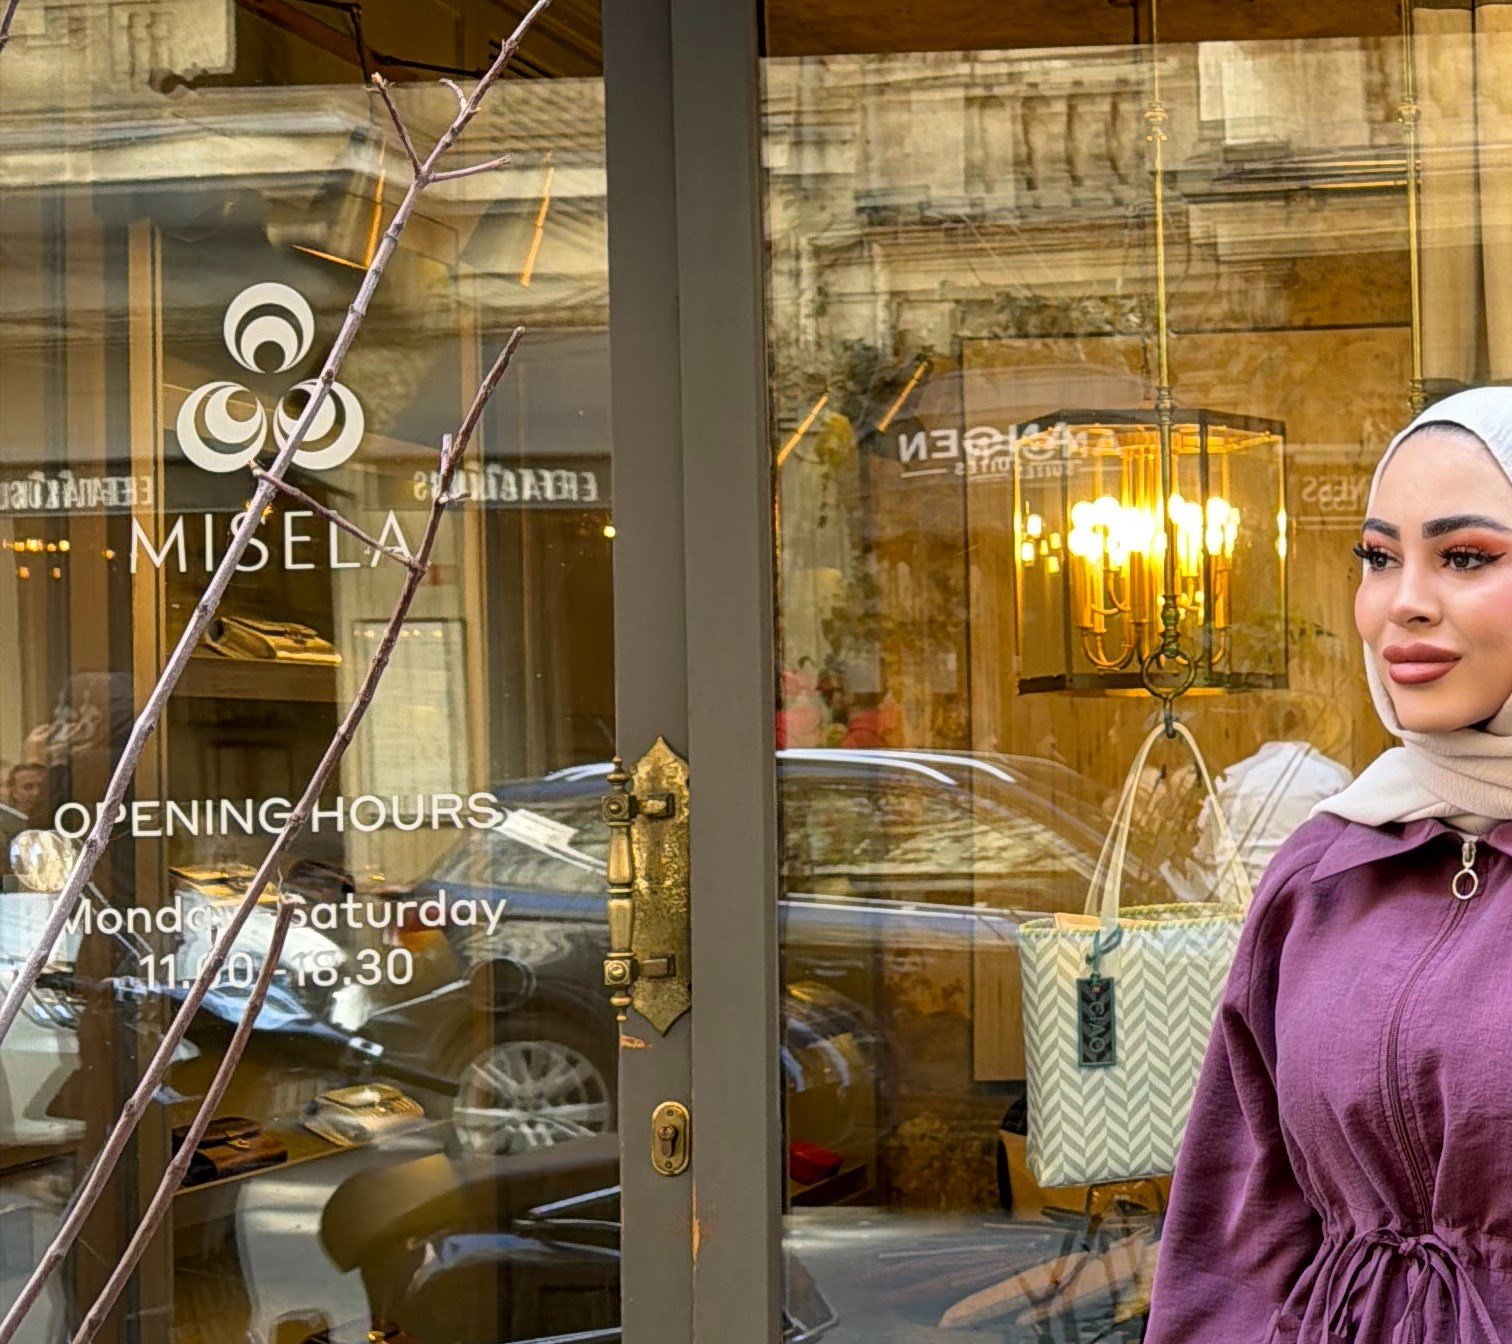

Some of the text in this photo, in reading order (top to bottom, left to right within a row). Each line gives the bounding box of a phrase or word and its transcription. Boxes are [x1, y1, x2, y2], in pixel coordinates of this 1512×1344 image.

[130, 509, 418, 574] MISELA
[54, 792, 503, 839] OPENING HOURS
